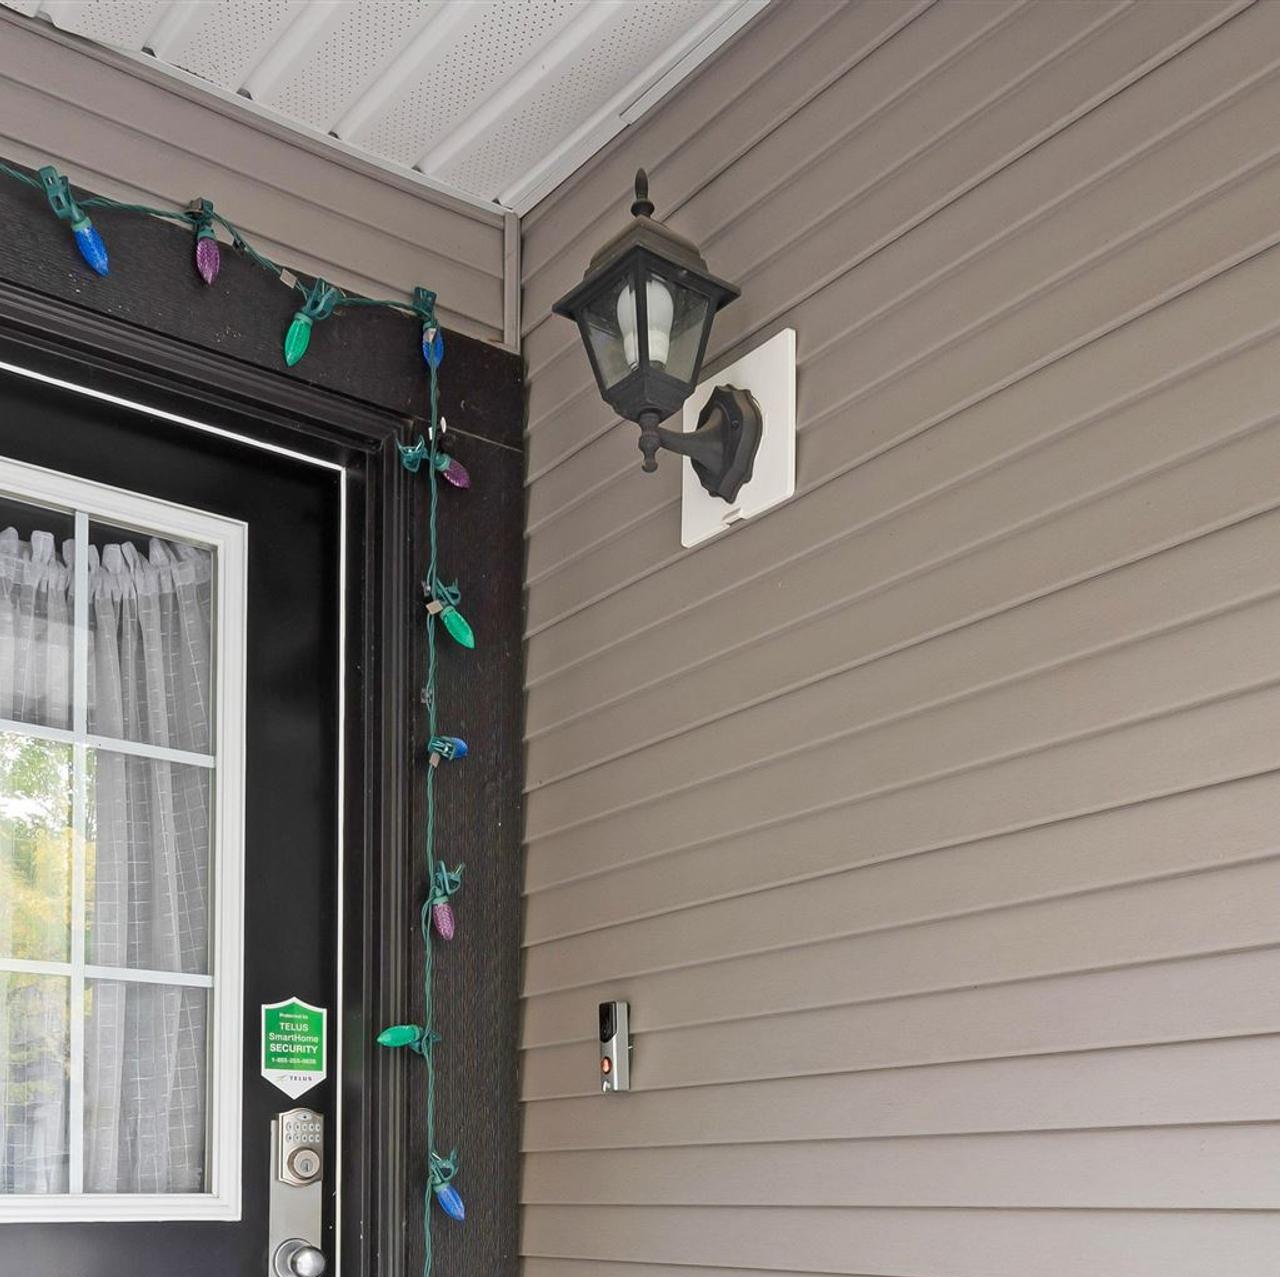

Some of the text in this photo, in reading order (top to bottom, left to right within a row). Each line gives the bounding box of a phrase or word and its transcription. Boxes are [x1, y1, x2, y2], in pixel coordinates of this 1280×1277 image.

[280, 1022, 309, 1032] TELUS
[269, 1032, 319, 1043] SmartHome
[270, 1043, 318, 1054] SECURITY
